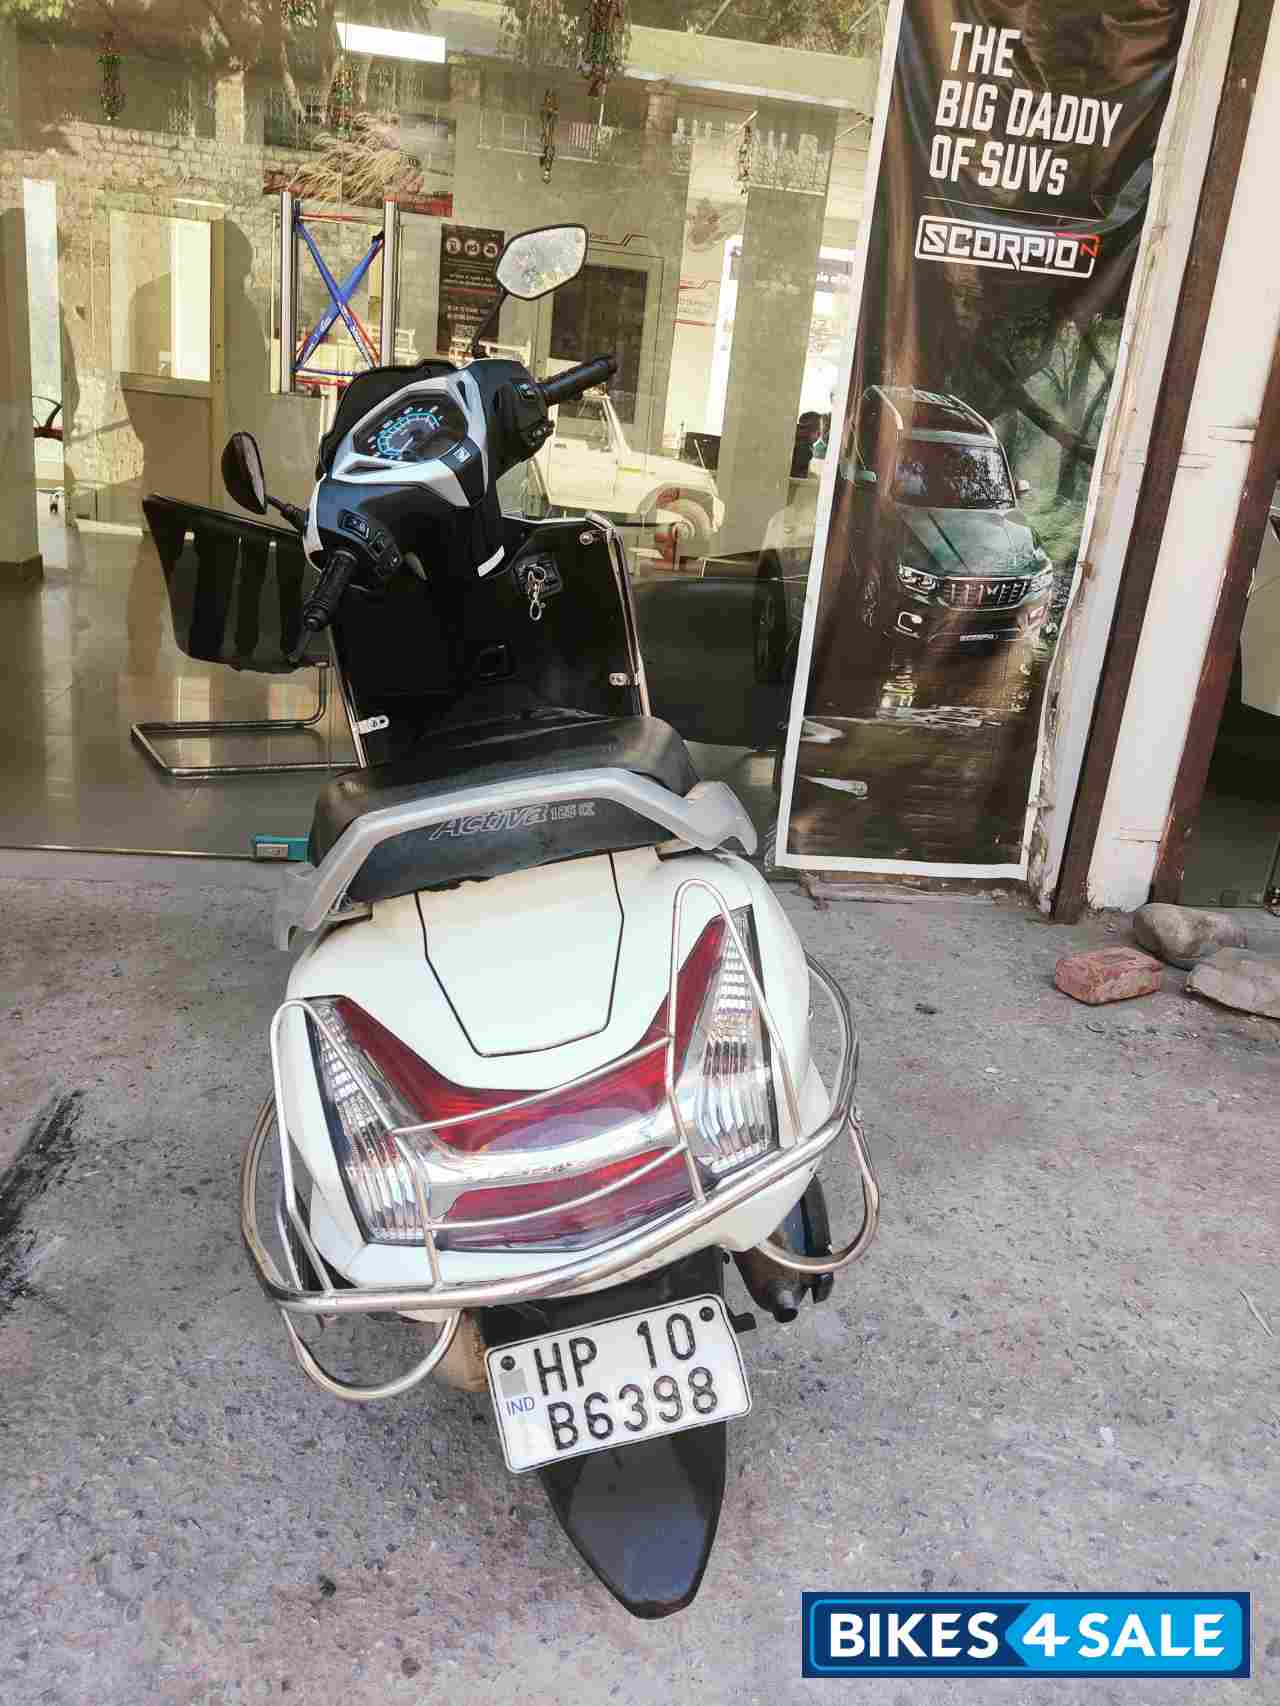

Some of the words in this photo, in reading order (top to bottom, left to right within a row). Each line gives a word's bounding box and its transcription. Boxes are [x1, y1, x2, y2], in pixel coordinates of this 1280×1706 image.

[950, 22, 1022, 78] THE
[935, 79, 998, 132] BIG
[1005, 87, 1123, 148] DADDY
[929, 134, 976, 182] OF
[978, 141, 1068, 195] SUVs
[534, 1336, 598, 1396] HP
[637, 1313, 696, 1369] 10
[505, 1396, 536, 1417] IND
[547, 1366, 718, 1450] B6398
